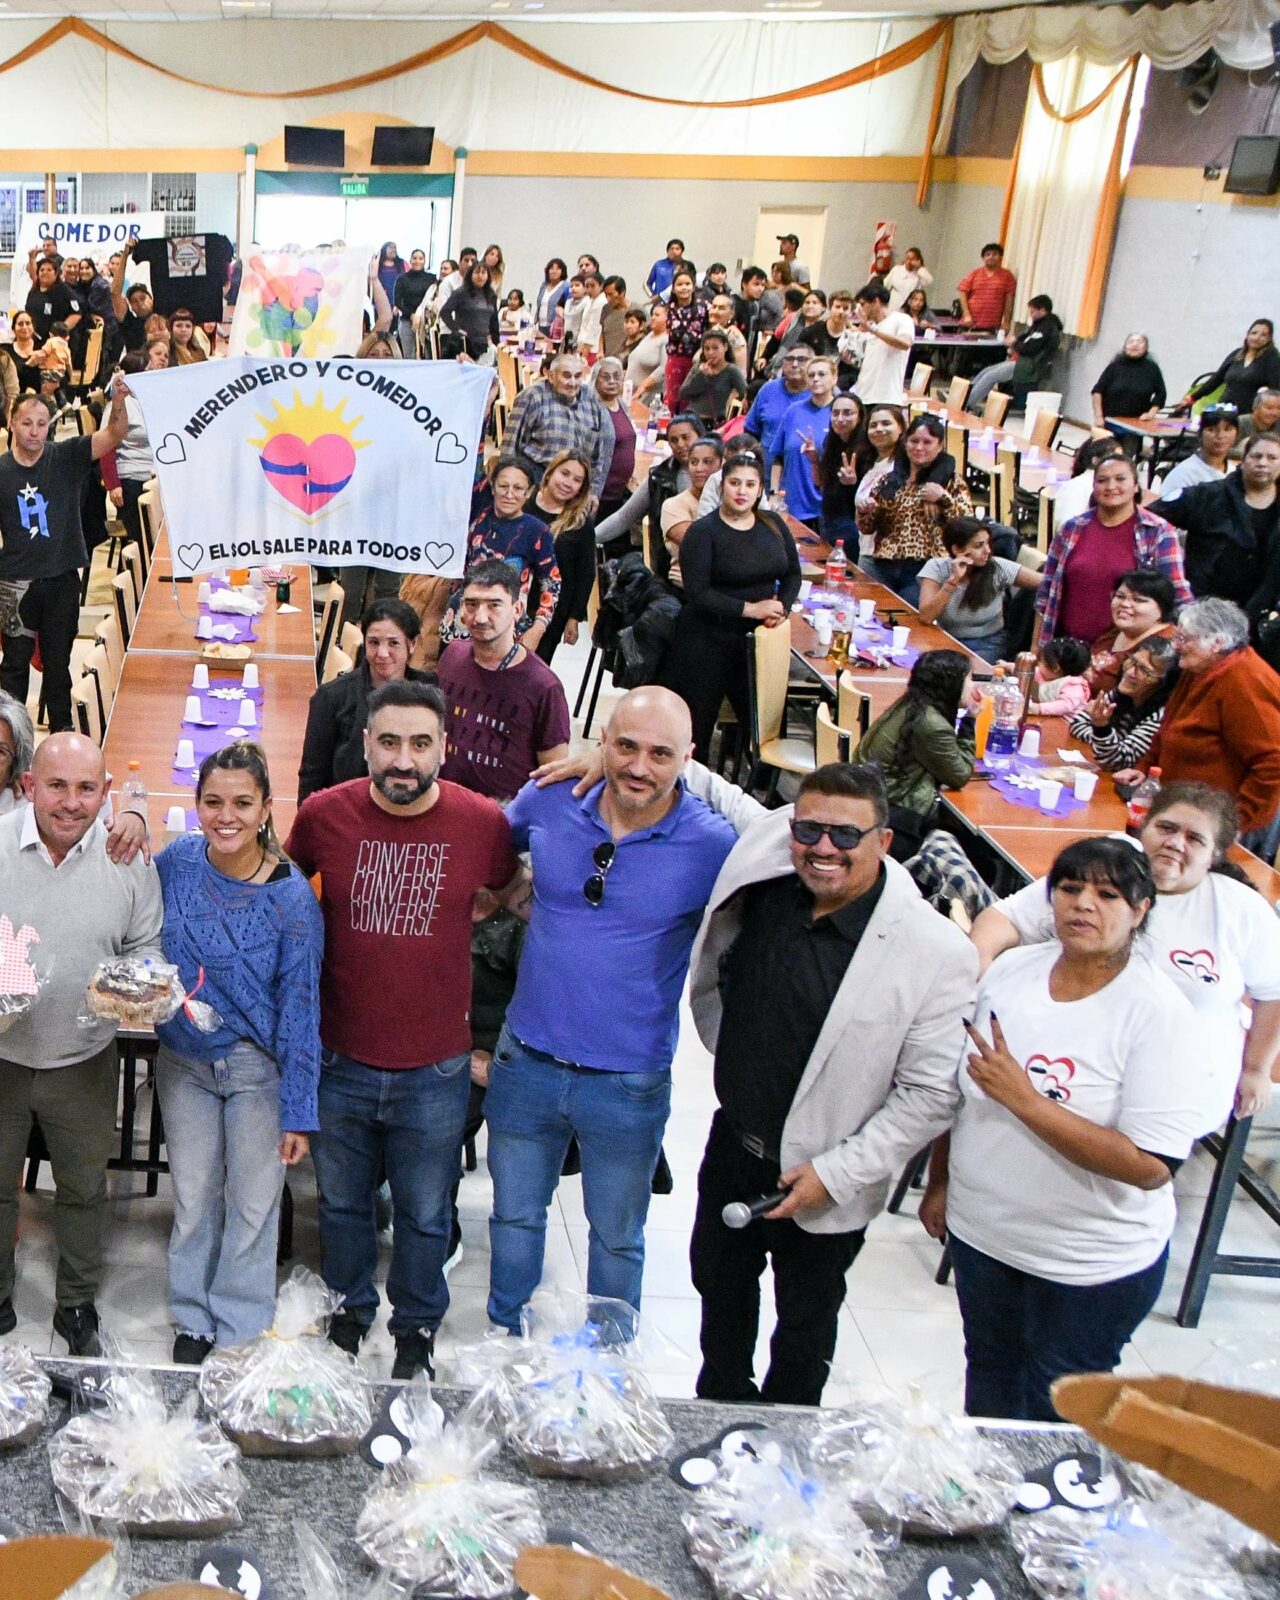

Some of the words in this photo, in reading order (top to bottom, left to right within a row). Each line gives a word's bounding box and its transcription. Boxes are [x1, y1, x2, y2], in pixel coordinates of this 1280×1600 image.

[342, 183, 367, 195] SALIDA
[38, 222, 141, 243] COMEDOR
[184, 361, 308, 439] MERENDERO
[316, 360, 331, 378] Y
[336, 364, 443, 437] COMEDOR
[209, 543, 230, 561] EL
[231, 539, 261, 558] SOL
[263, 537, 305, 555] SALE
[307, 539, 353, 556] PARA
[357, 539, 422, 562] TODOS
[467, 750, 503, 768] HEAD.
[356, 839, 451, 876] CONVERSE
[350, 871, 447, 907] CONVERSE
[350, 900, 441, 936] CONVERSE
